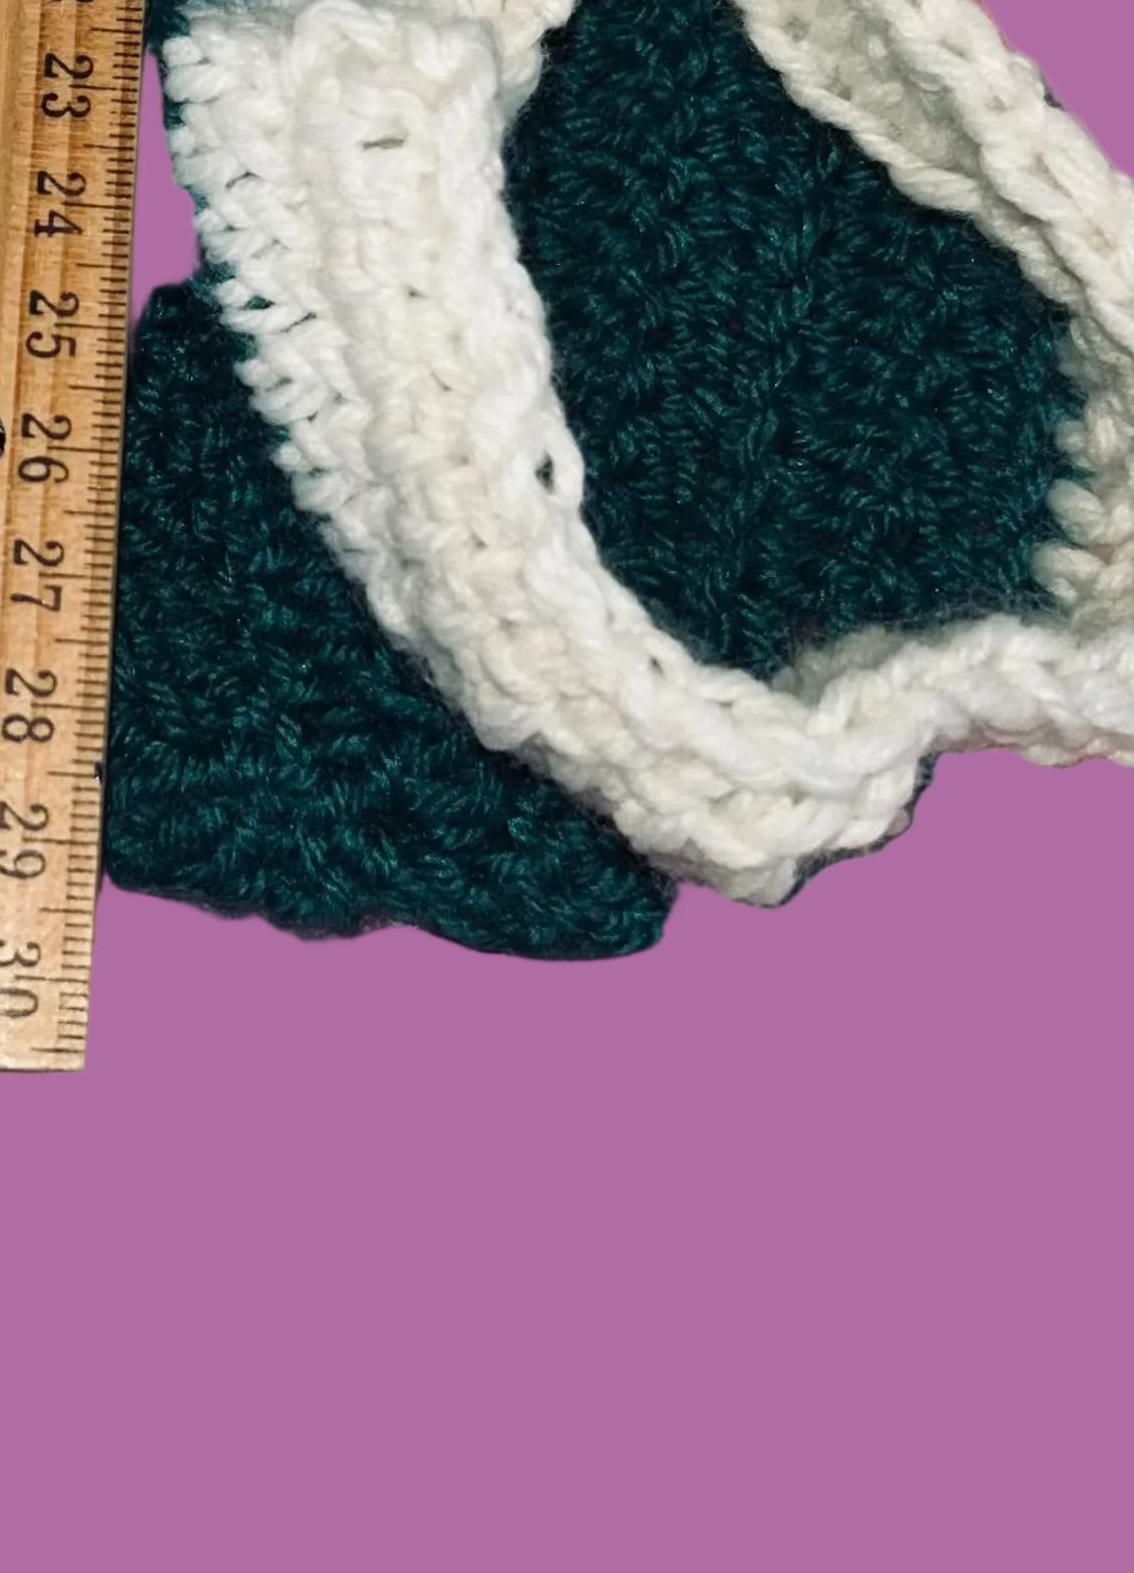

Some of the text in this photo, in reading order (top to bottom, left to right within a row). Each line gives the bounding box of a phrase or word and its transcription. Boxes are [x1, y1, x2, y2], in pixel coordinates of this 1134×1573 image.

[41, 53, 94, 119] 23
[34, 170, 87, 238] 24
[25, 289, 80, 358] 25
[17, 412, 73, 484] 26
[10, 538, 65, 612] 27
[0, 667, 57, 743] 28
